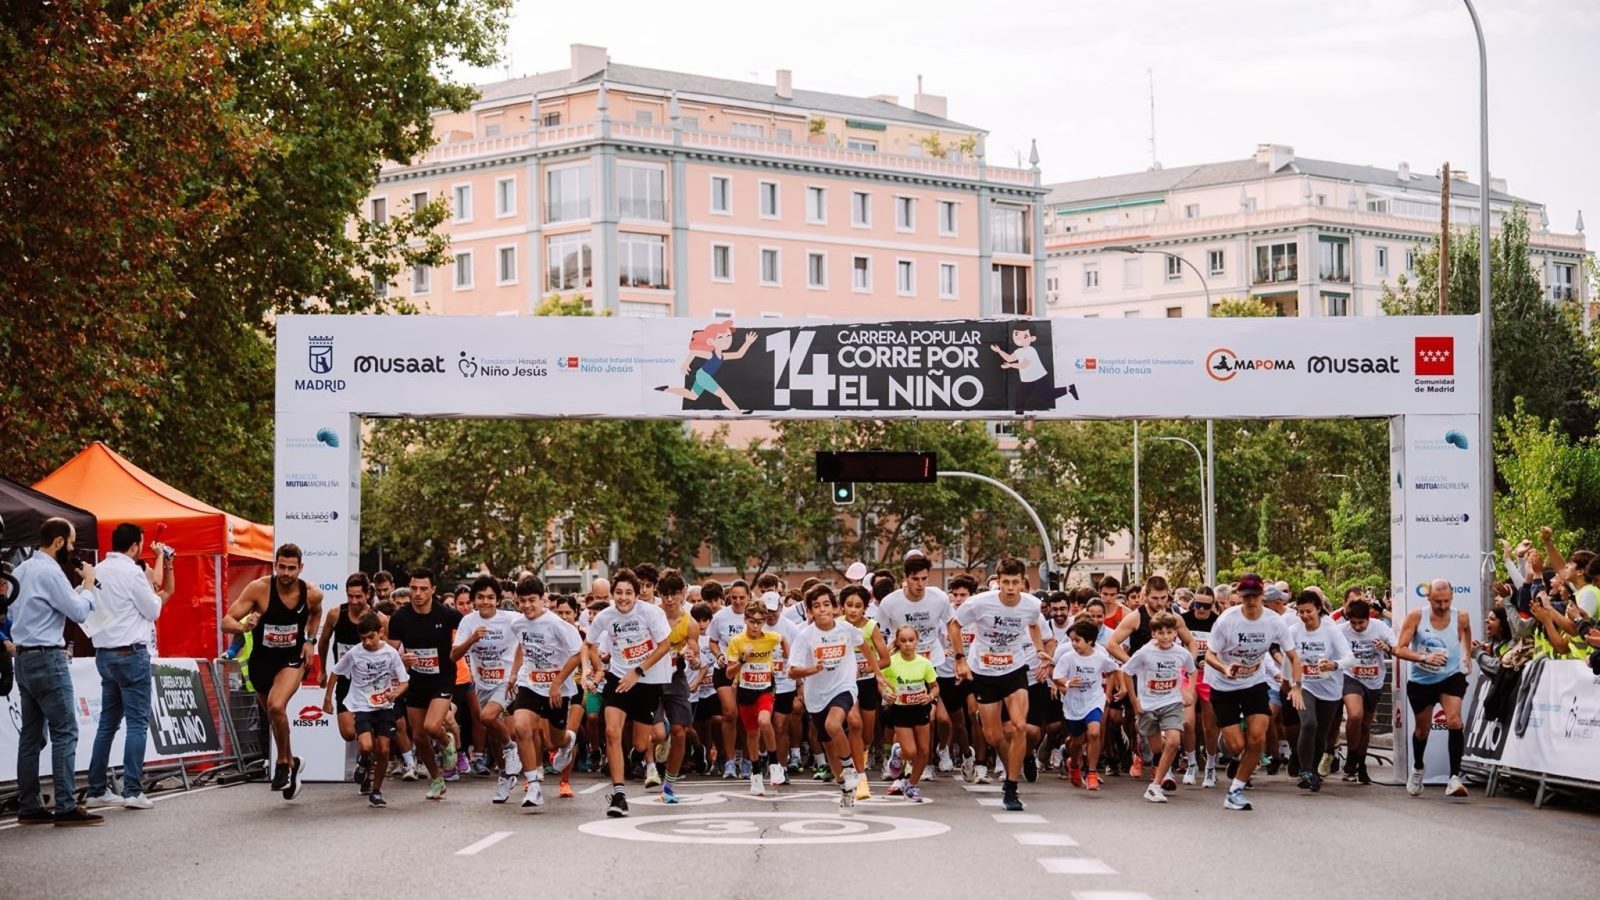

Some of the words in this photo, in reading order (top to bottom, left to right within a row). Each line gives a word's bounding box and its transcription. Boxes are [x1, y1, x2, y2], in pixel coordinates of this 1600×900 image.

[837, 330, 909, 345] CARRERA
[911, 330, 982, 345] POPULAR
[353, 354, 446, 373] musaat
[518, 358, 547, 366] Hospital
[581, 357, 608, 365] Hospital
[634, 356, 676, 364] Universitario
[837, 346, 921, 369] CORRE
[928, 346, 981, 368] POR
[1098, 358, 1126, 366] Hospital
[581, 364, 602, 373] Niño
[605, 364, 634, 373] Jesús
[766, 330, 835, 406] 14
[1234, 359, 1296, 371] MAPOMA
[1307, 355, 1400, 373] musaat
[480, 365, 509, 377] Niño
[512, 365, 548, 377] Jesús
[1098, 366, 1122, 375] Niño
[1125, 366, 1152, 375] Jesús
[295, 379, 346, 393] MADRID
[839, 376, 879, 406] EL
[888, 369, 985, 407] NIÑO
[1415, 378, 1455, 386] Comunidad
[749, 674, 767, 682] 7190
[1154, 682, 1173, 690] 6244
[181, 710, 207, 744] NIÑO
[293, 719, 313, 727] KISS
[315, 719, 329, 727] FM
